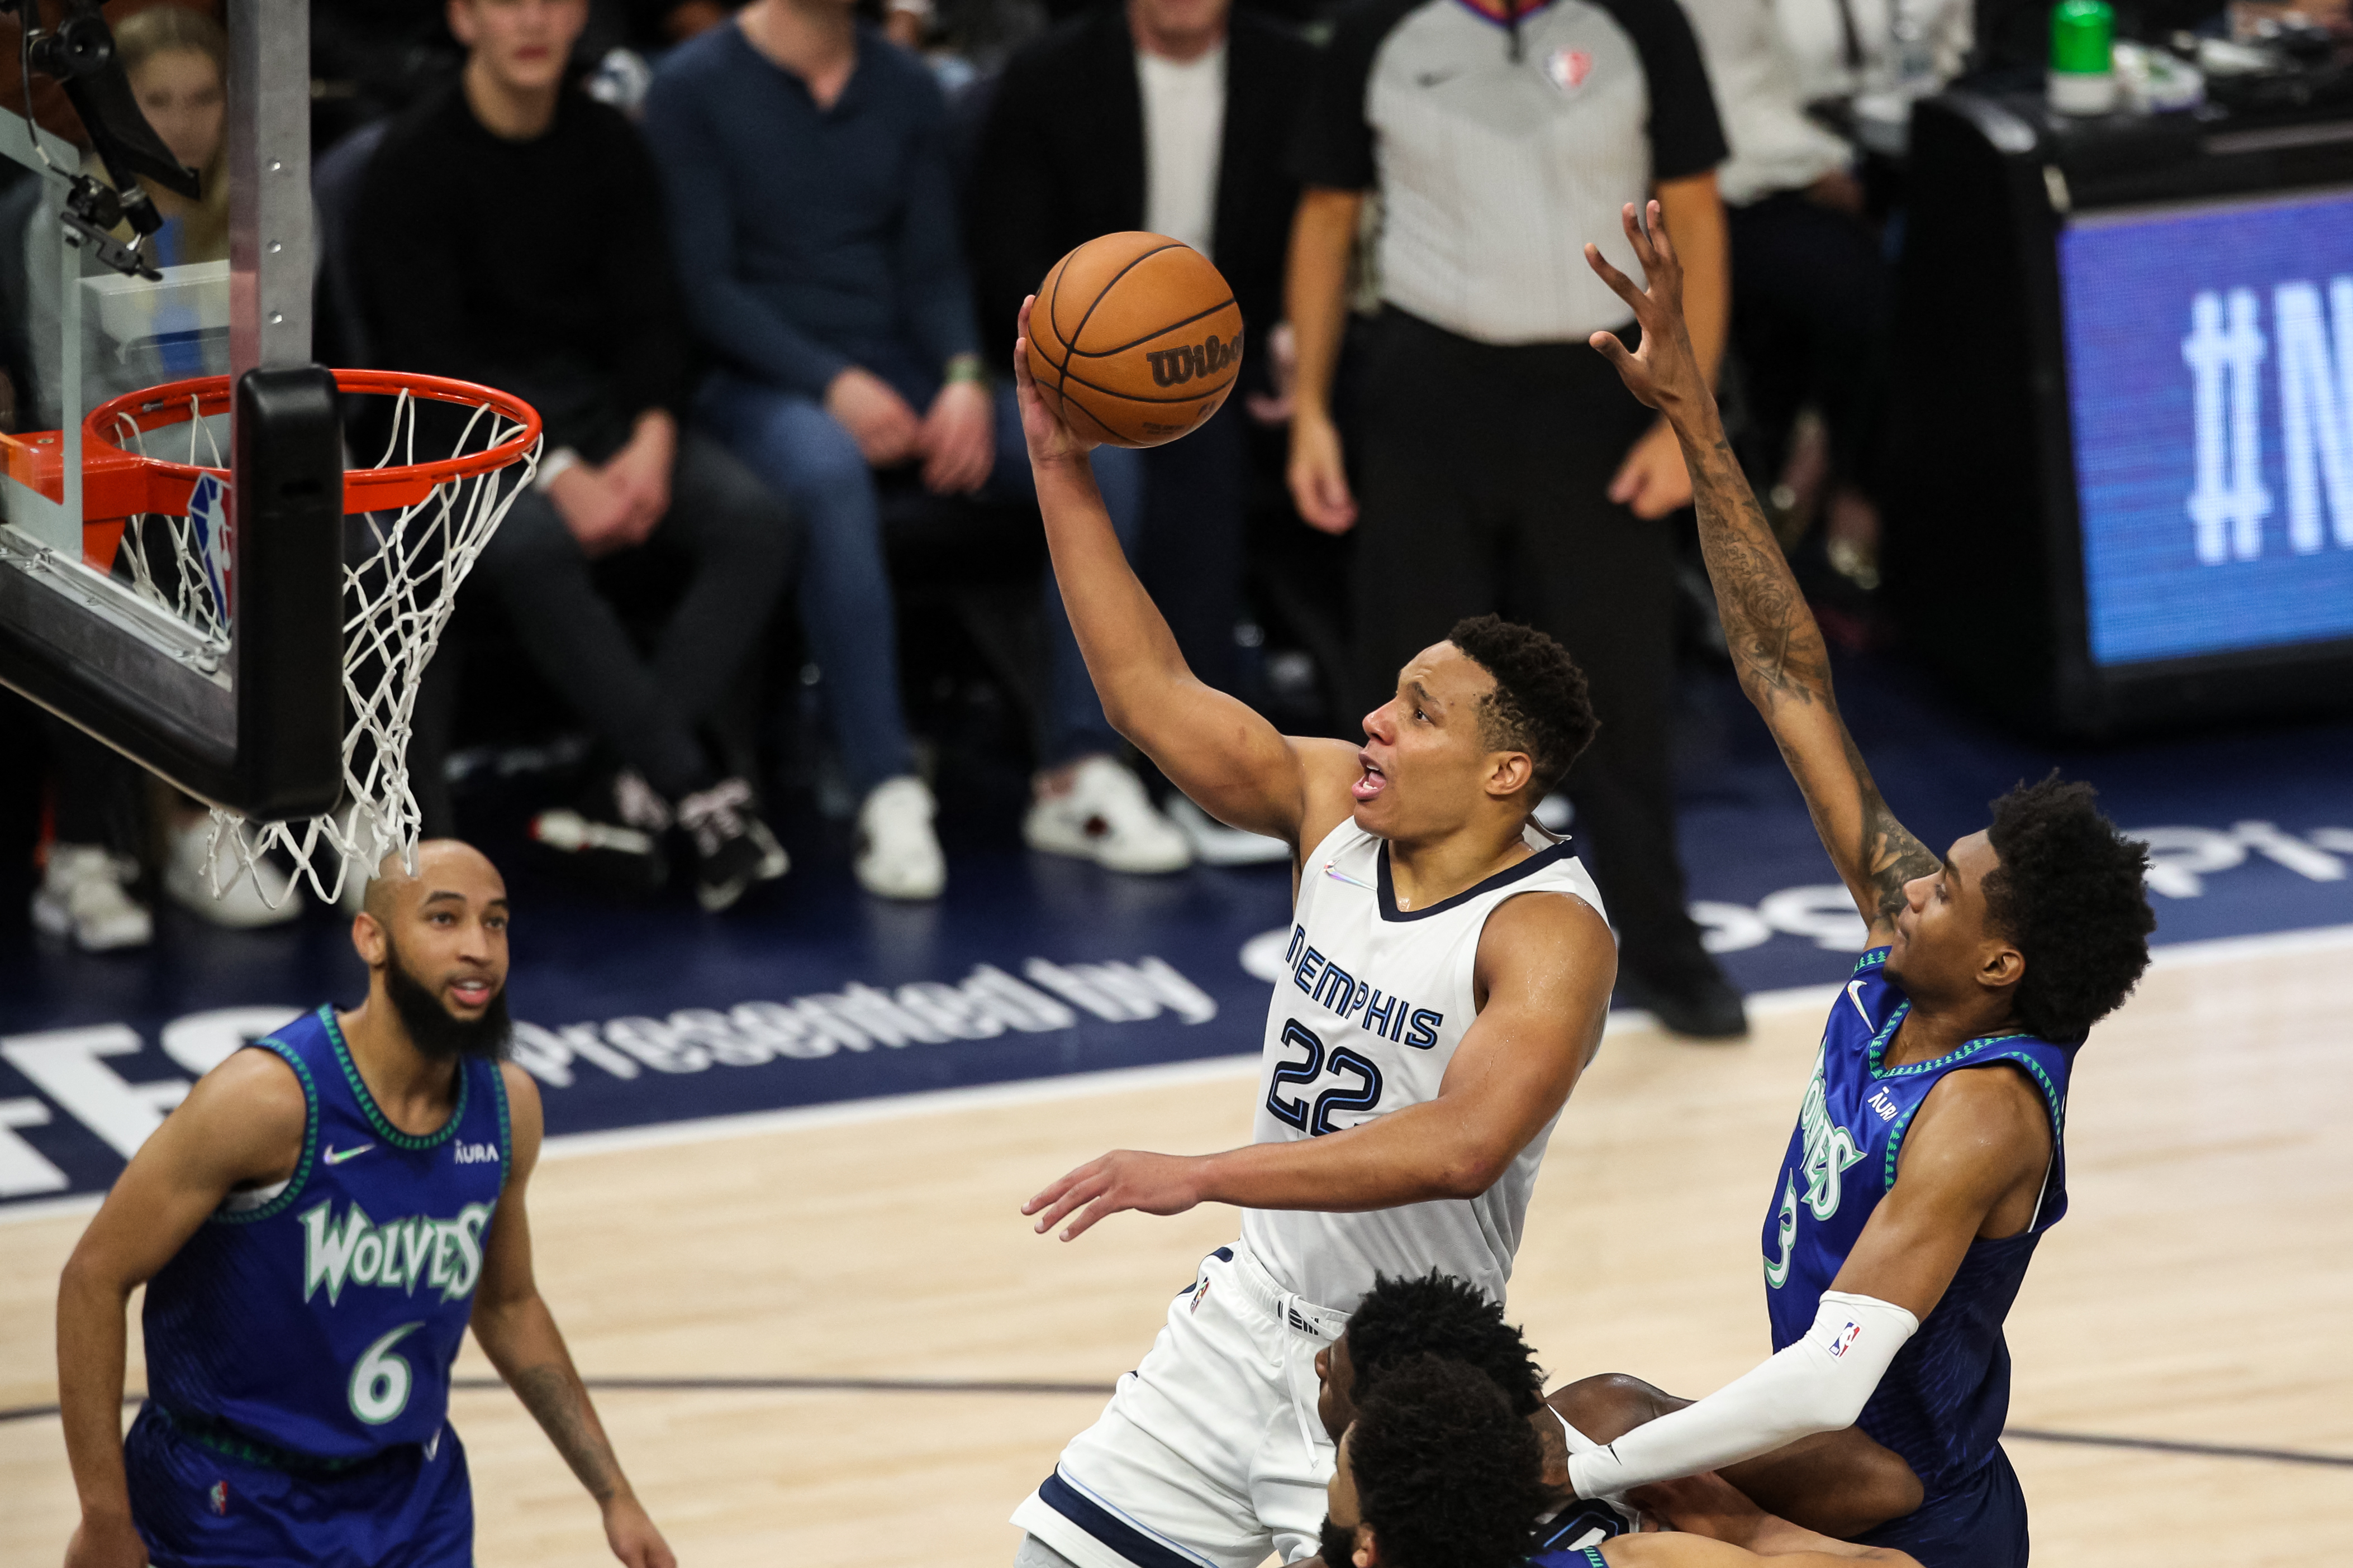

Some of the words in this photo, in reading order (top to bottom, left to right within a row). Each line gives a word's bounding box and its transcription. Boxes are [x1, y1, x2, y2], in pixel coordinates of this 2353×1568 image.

[1146, 330, 1244, 388] Wilso
[1021, 955, 1218, 1027] by
[1285, 922, 1444, 1051] MEMPHIS
[1266, 1018, 1383, 1138] 22
[297, 1199, 497, 1308] WOLVES
[347, 1320, 426, 1426] 6
